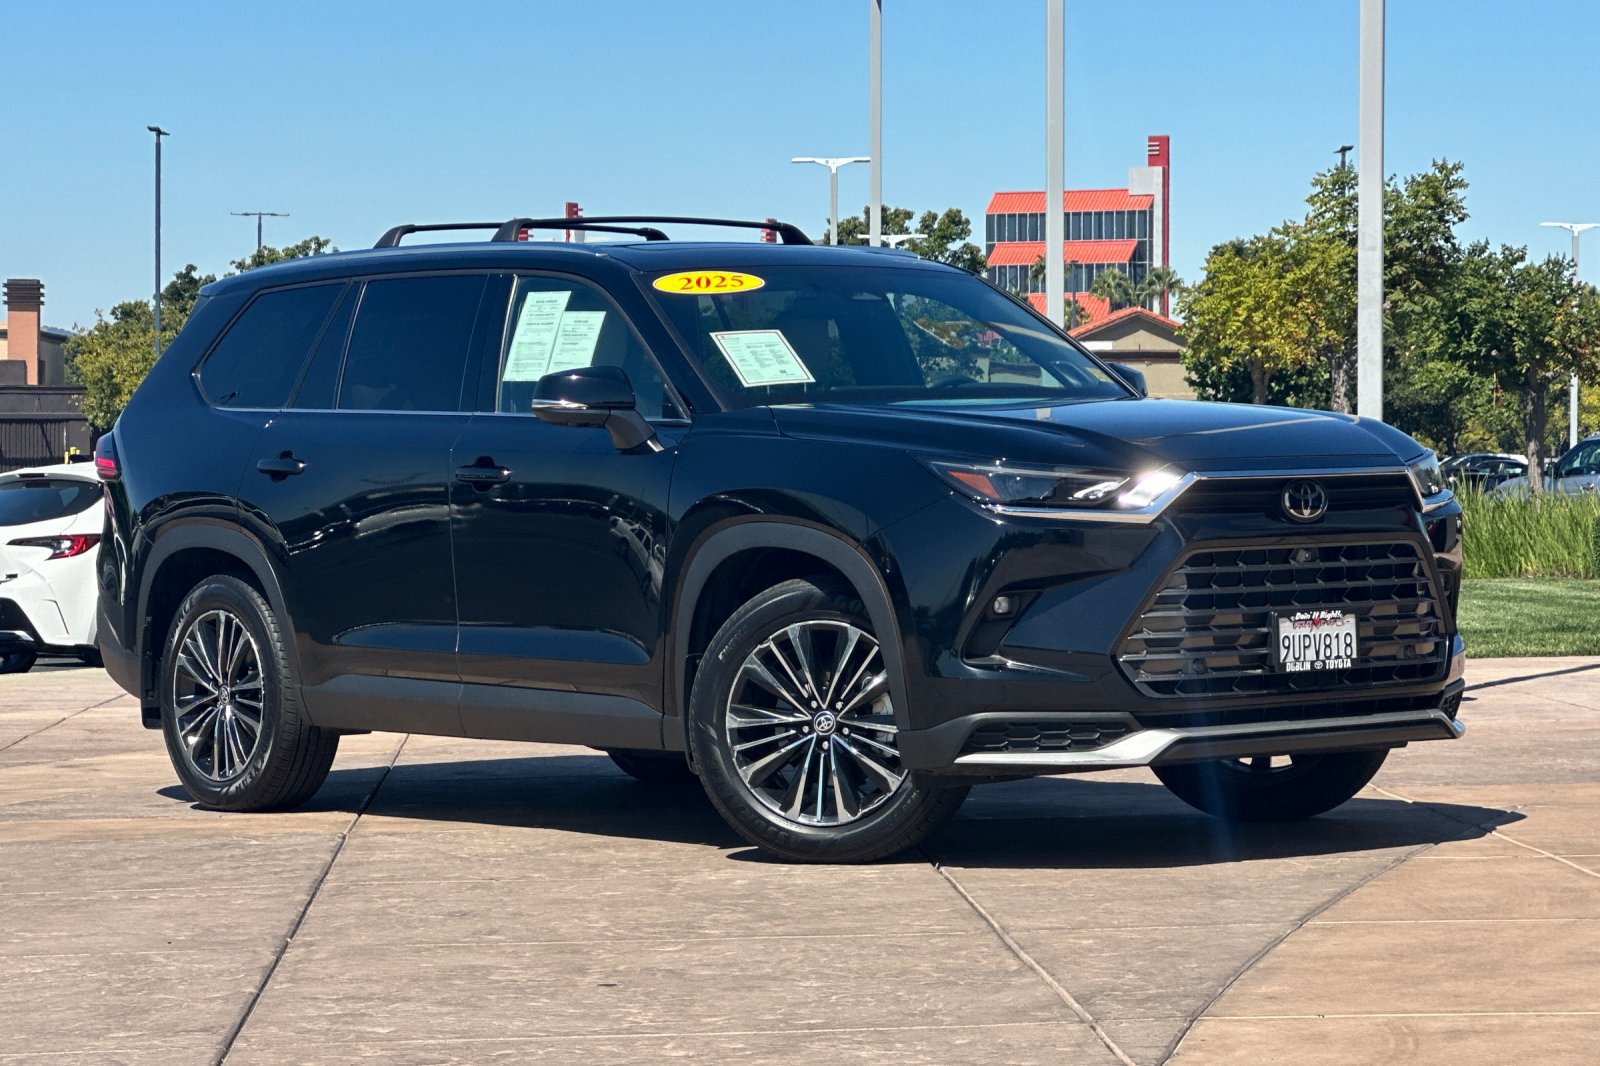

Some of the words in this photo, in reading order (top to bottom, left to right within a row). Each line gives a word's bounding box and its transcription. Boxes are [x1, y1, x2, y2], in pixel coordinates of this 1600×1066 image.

[678, 275, 744, 290] 2025
[1282, 632, 1353, 662] 9UPV818
[1286, 662, 1311, 672] DUBLIN
[1325, 658, 1351, 669] TOYOTA
